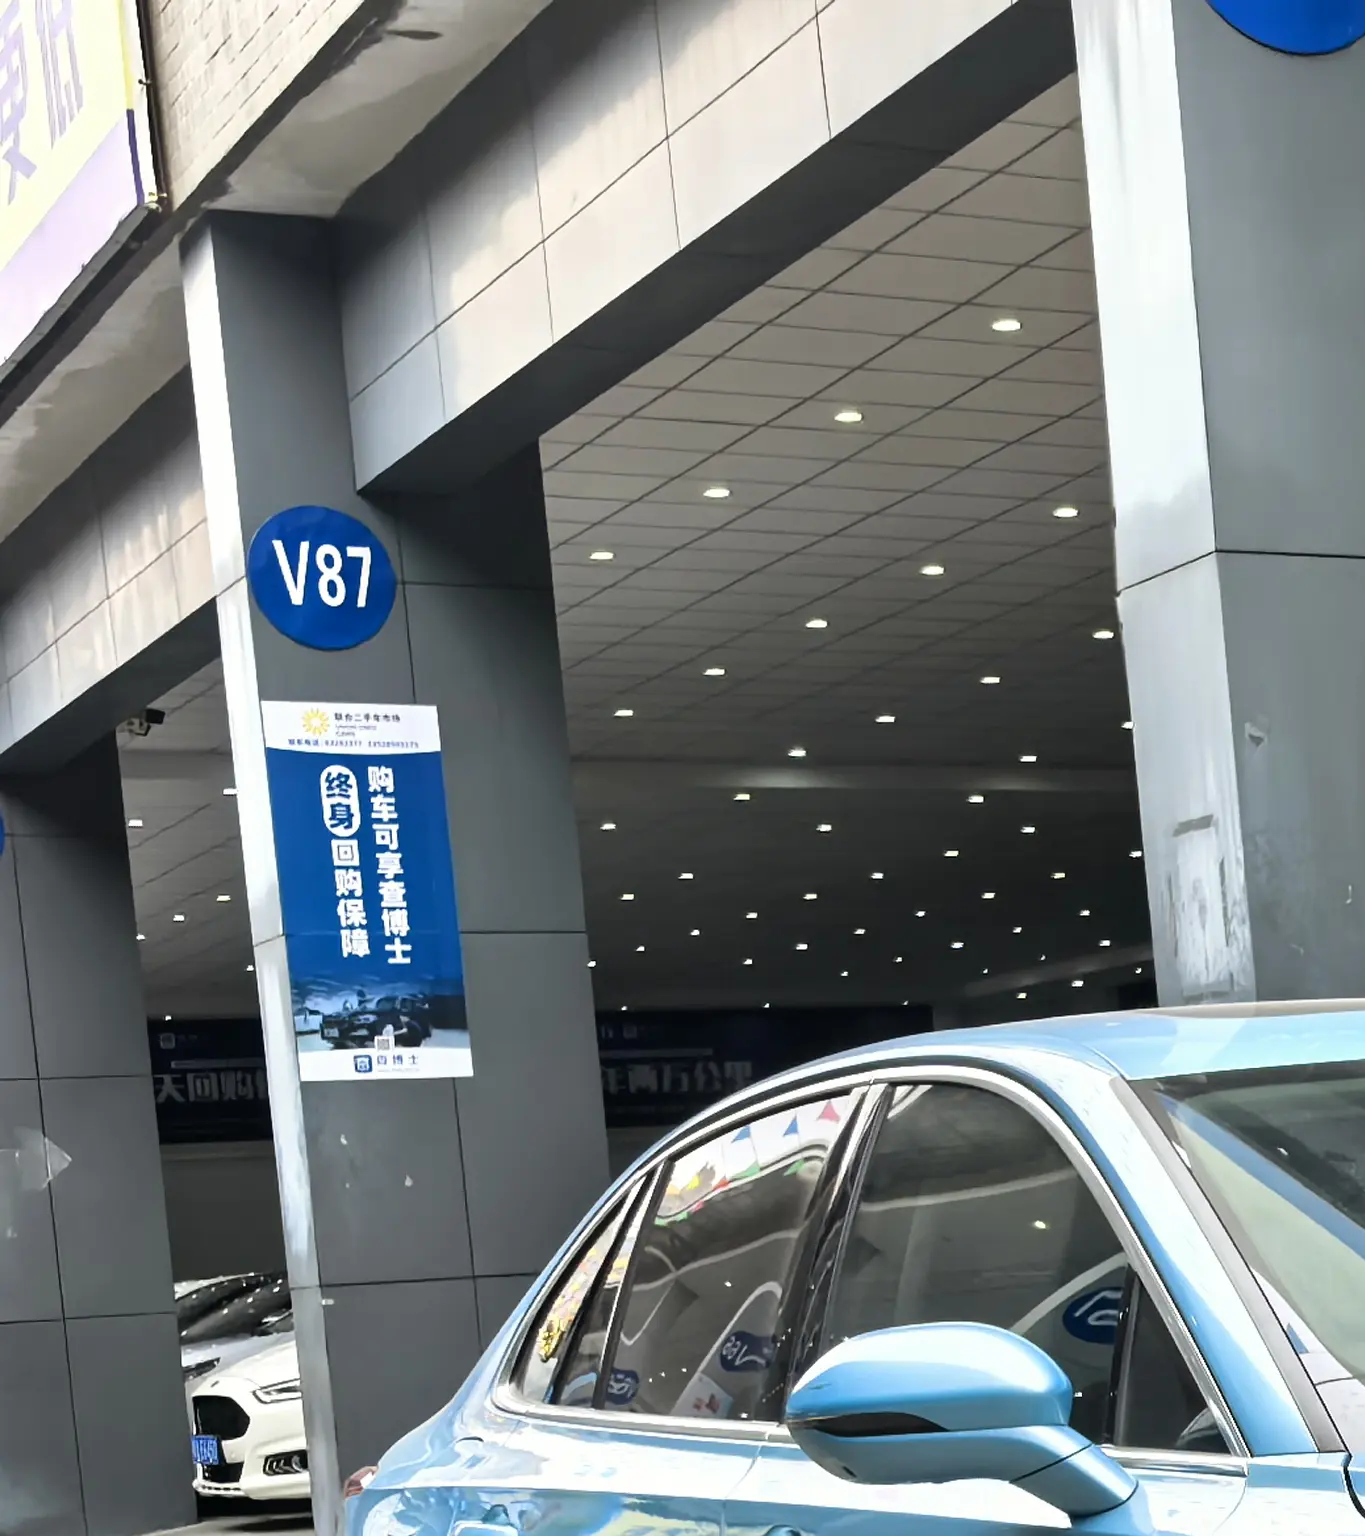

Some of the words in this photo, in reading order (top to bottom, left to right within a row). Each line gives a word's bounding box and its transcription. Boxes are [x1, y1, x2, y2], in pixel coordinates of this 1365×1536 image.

[271, 539, 372, 608] V87
[324, 771, 370, 958] 终身回购保障
[367, 765, 412, 964] 购车可享查博士
